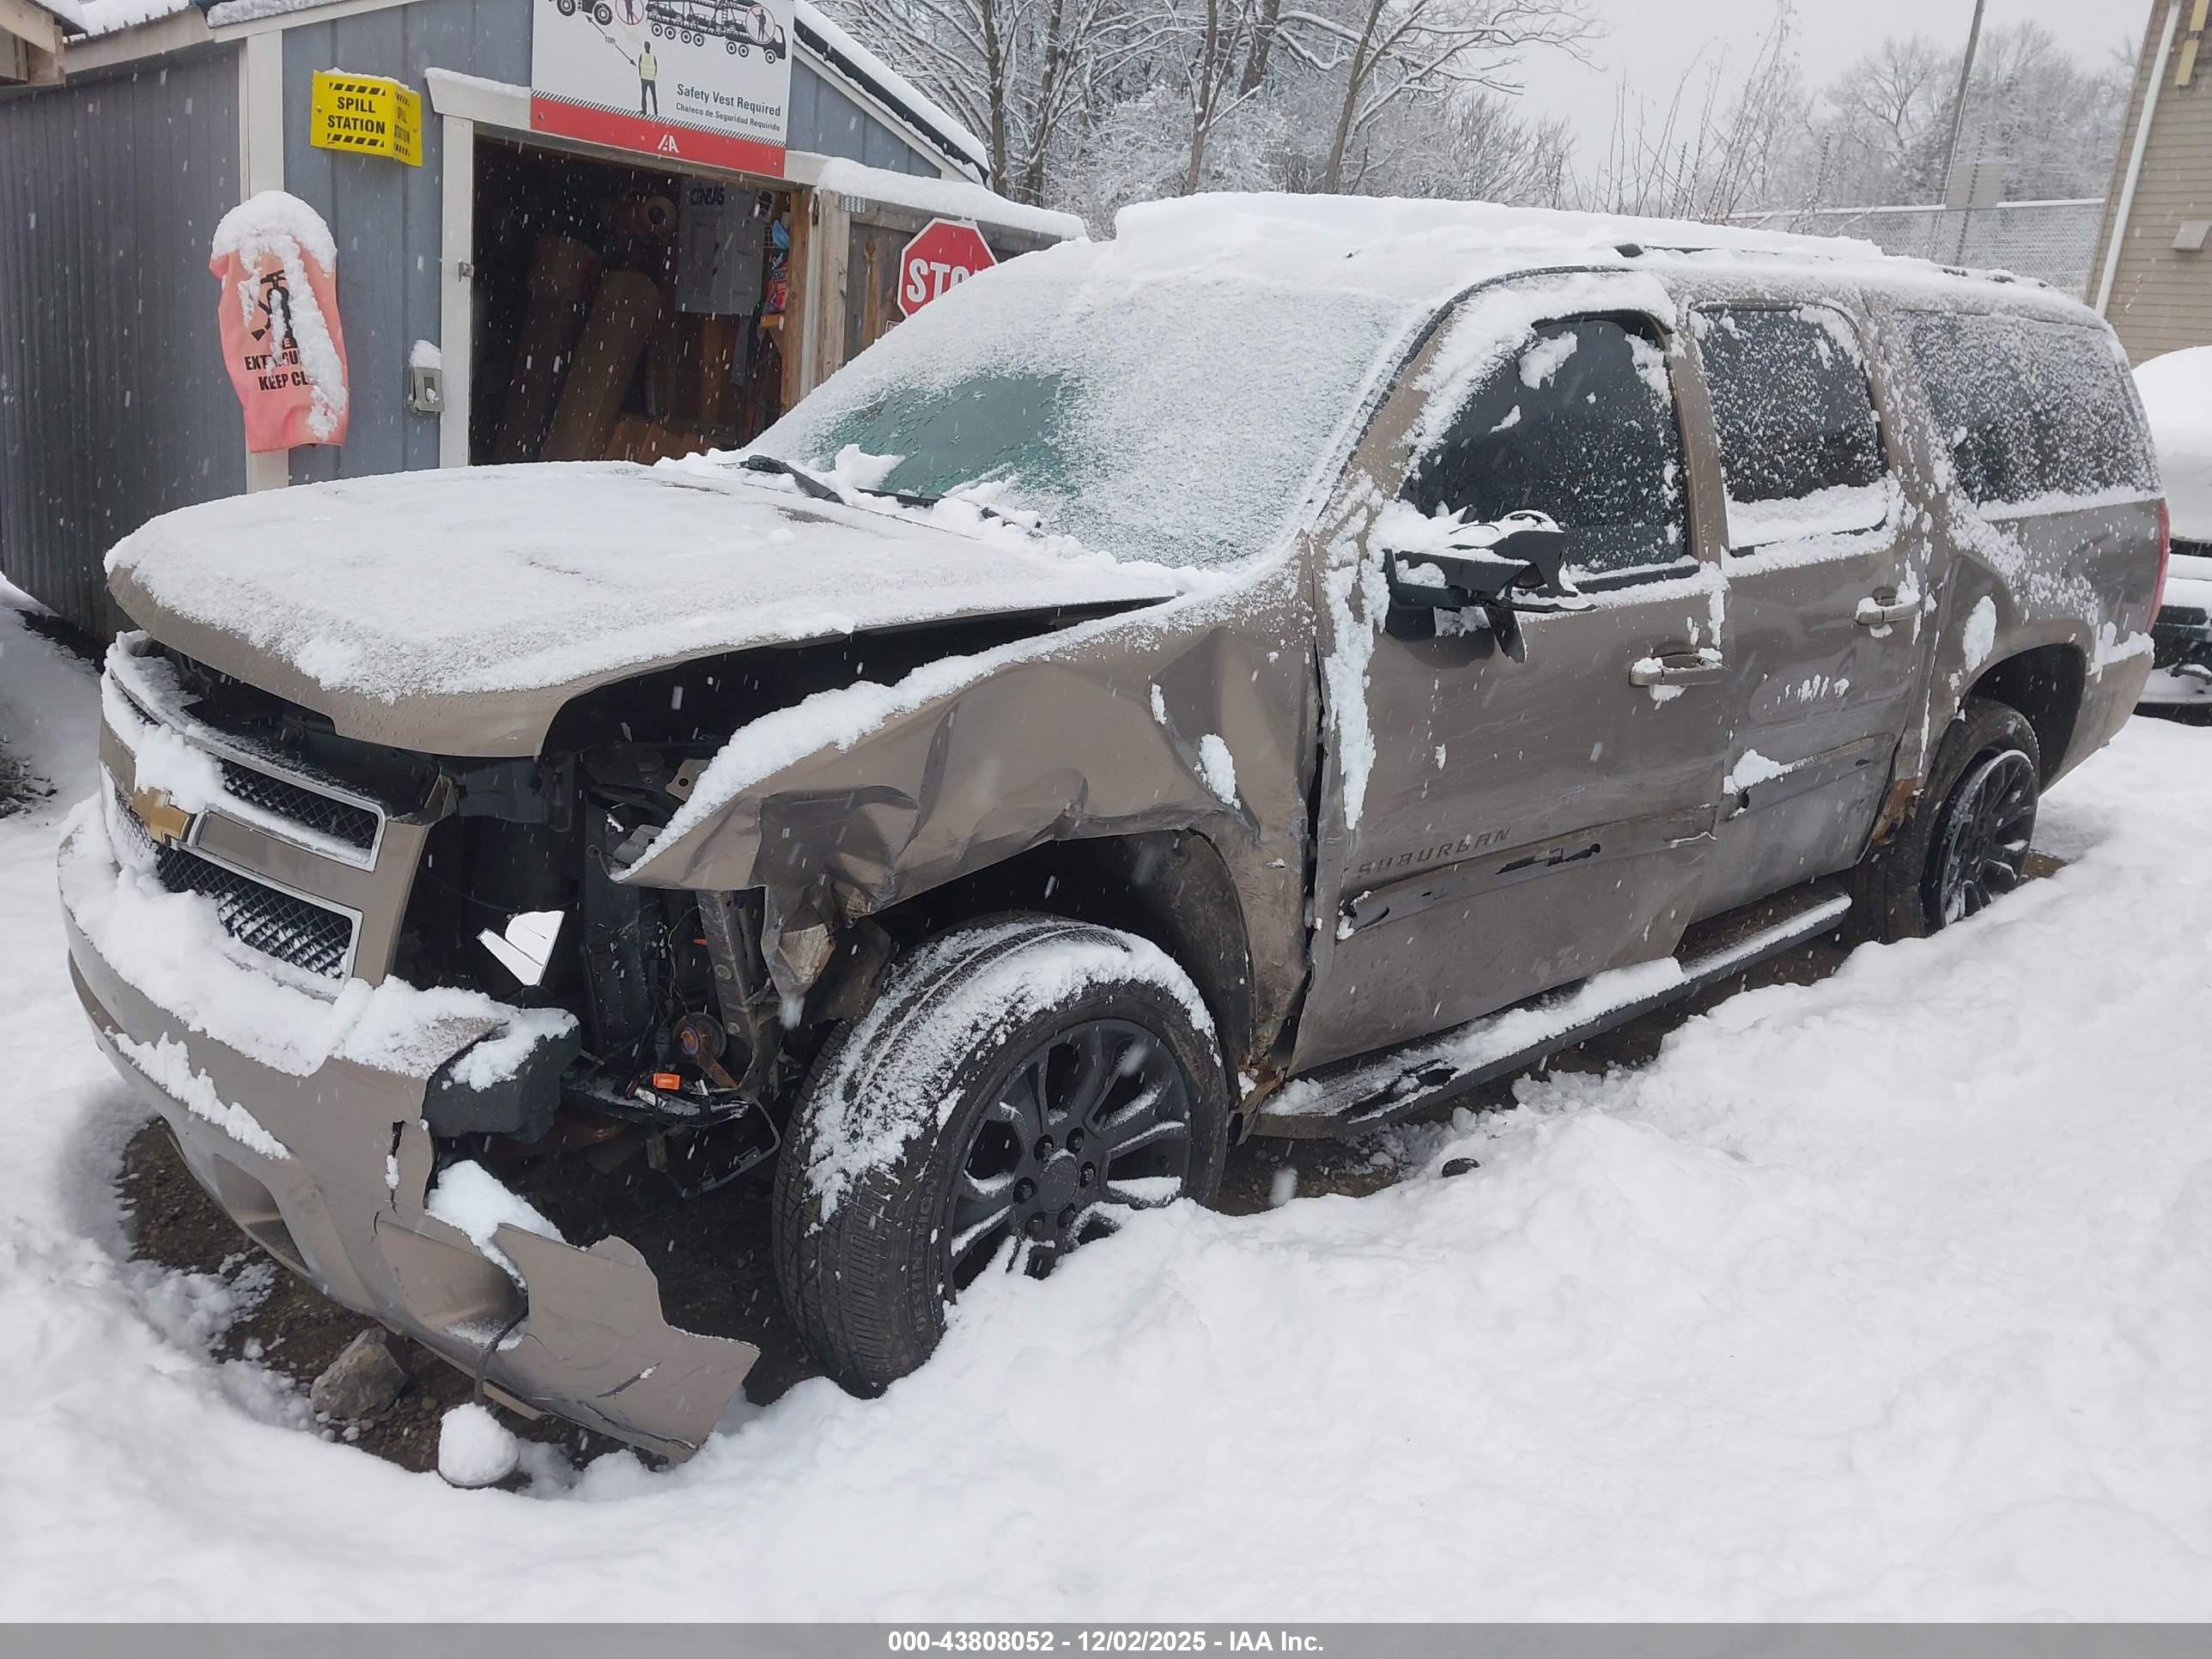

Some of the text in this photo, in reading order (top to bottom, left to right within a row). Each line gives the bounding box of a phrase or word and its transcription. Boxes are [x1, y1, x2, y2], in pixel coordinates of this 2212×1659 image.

[337, 96, 376, 113] SPILL
[677, 83, 781, 117] Safety Vest Required
[676, 102, 704, 115] Chaleco
[705, 109, 714, 118] de
[715, 111, 749, 125] Seguridad
[327, 114, 386, 135] STATION
[258, 373, 289, 391] KEEP
